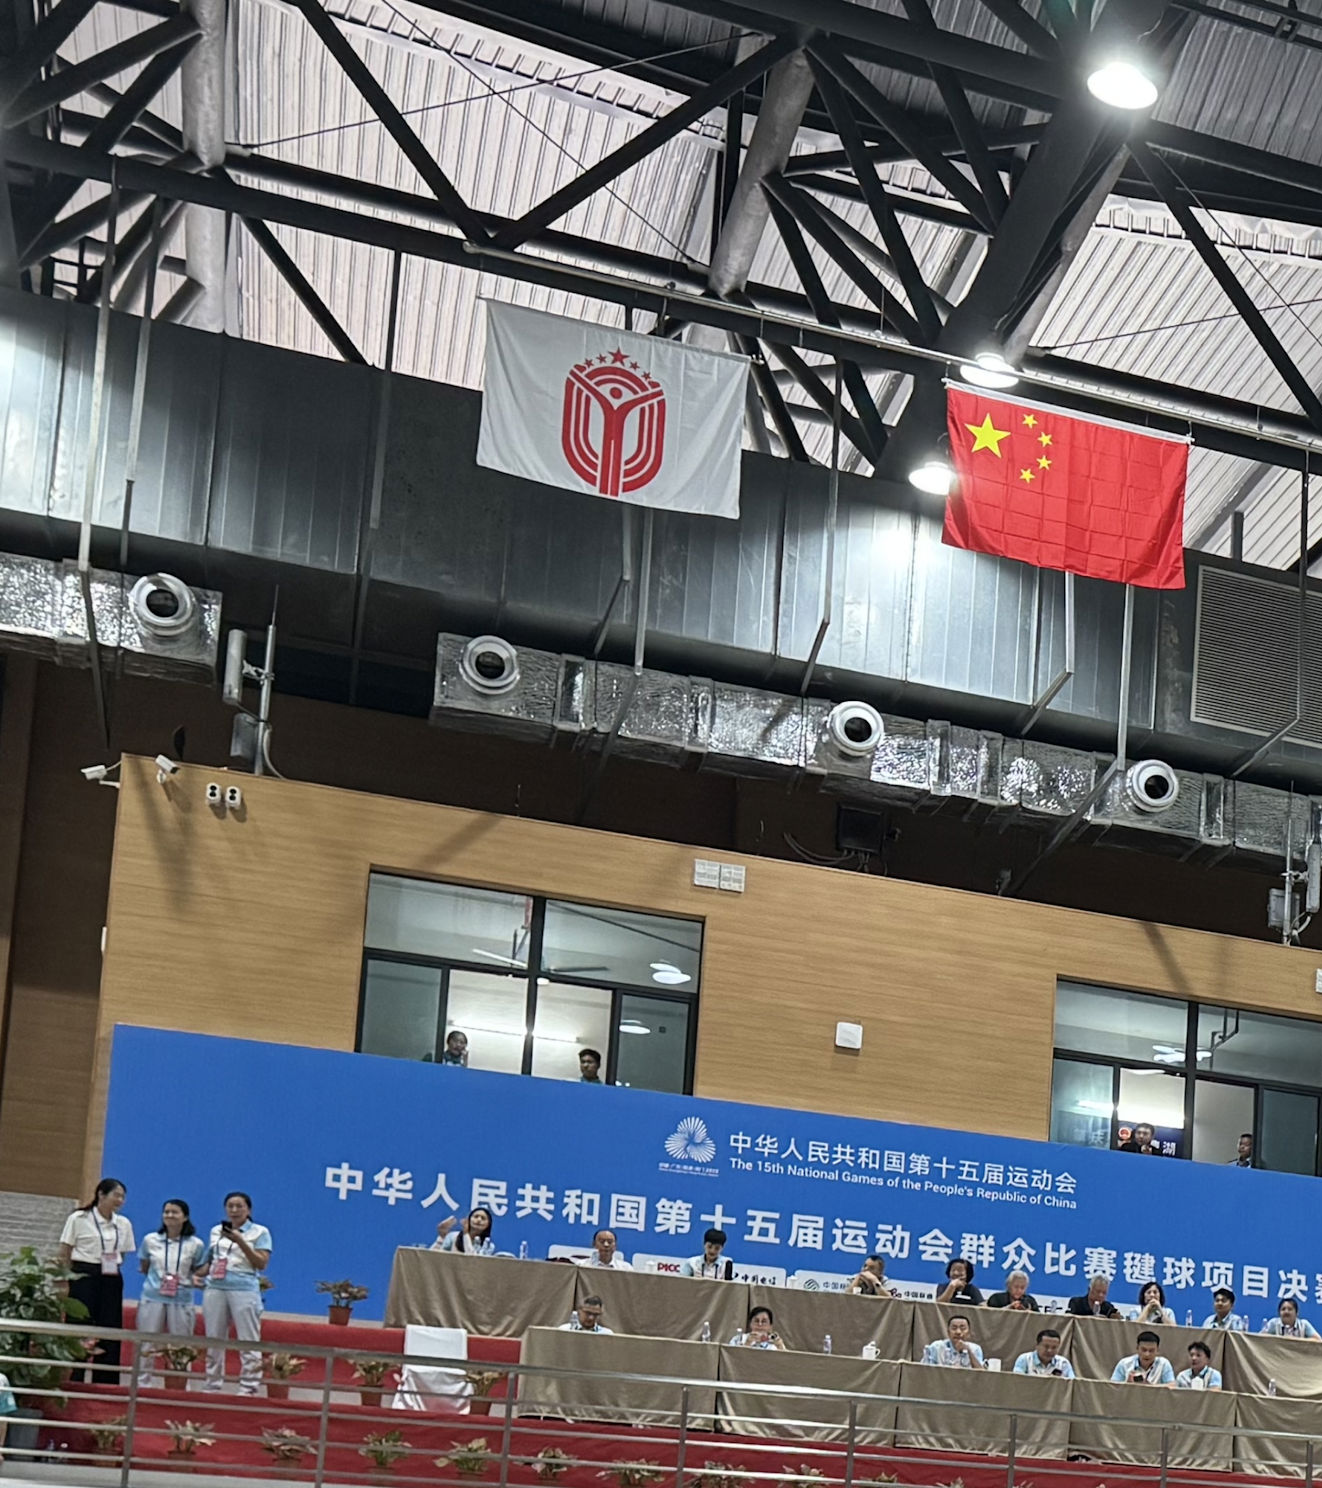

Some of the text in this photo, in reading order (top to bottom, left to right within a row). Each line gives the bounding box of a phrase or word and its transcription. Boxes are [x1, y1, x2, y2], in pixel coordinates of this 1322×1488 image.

[729, 1131, 1078, 1194] 中华人民共和国第十五届运动会
[729, 1157, 753, 1171] The
[757, 1161, 784, 1174] 15th
[787, 1165, 839, 1181] National
[842, 1172, 884, 1186] Games
[887, 1177, 900, 1188] of
[902, 1178, 921, 1190] the
[924, 1181, 974, 1197] People's
[976, 1187, 1027, 1204] Republic
[1029, 1194, 1042, 1205] of
[1044, 1195, 1077, 1209] China
[657, 1262, 681, 1273] PICC
